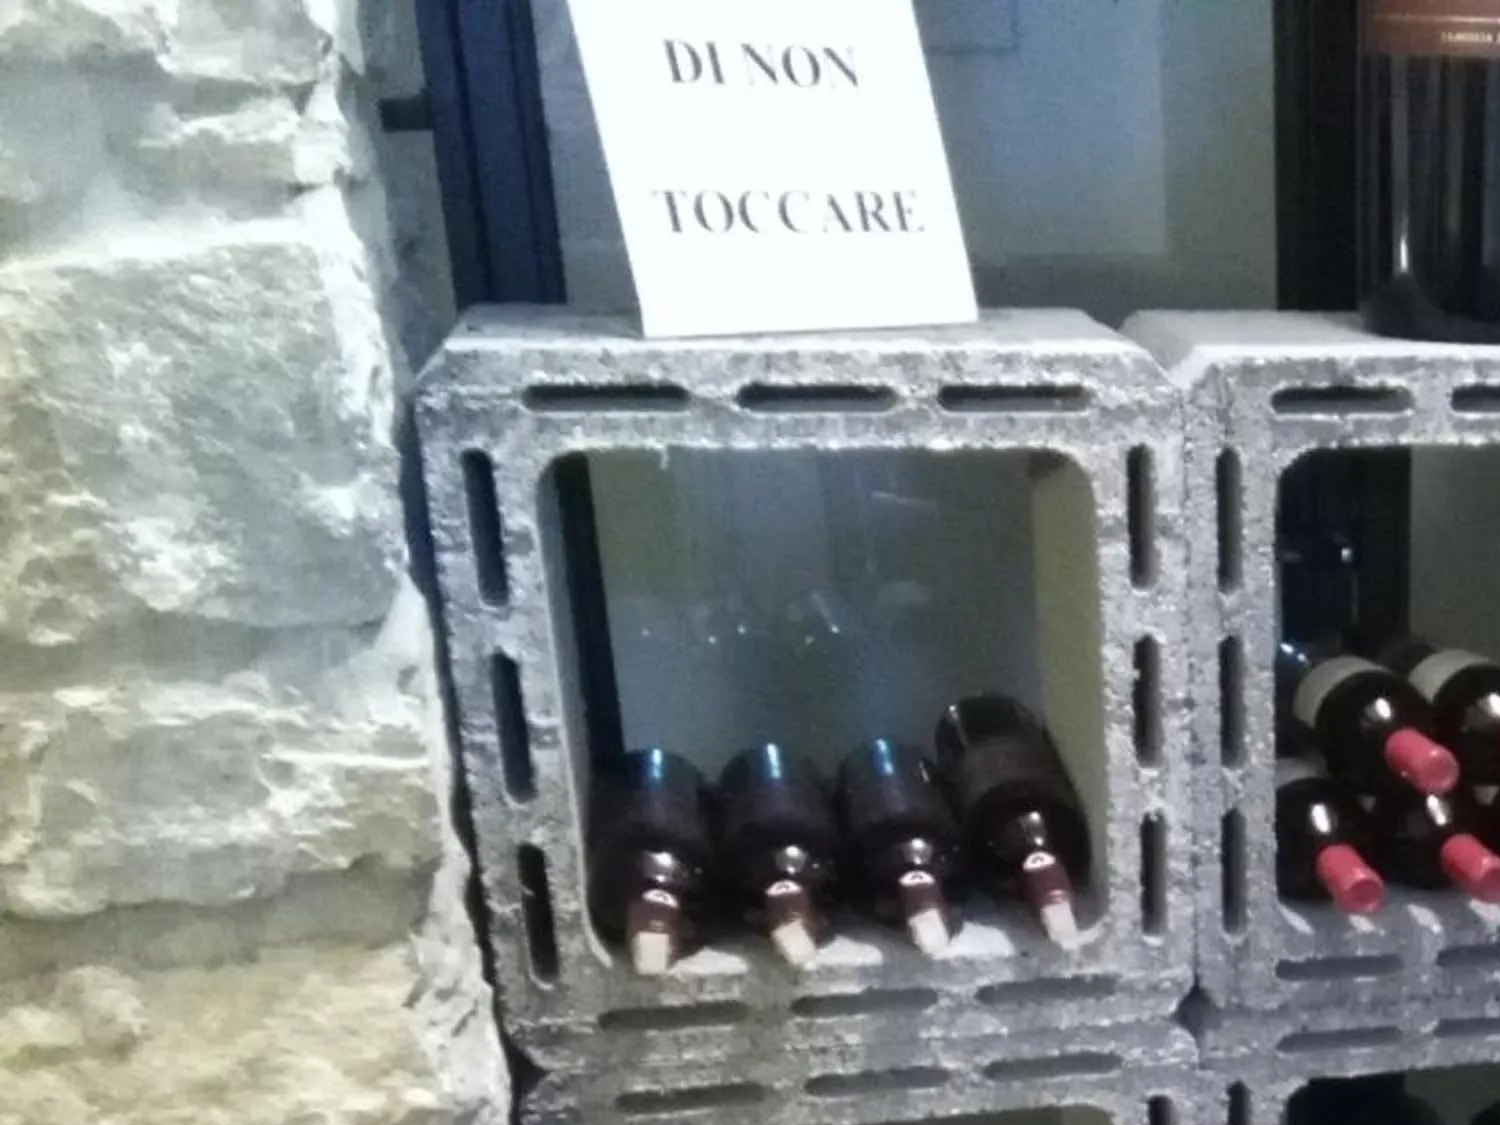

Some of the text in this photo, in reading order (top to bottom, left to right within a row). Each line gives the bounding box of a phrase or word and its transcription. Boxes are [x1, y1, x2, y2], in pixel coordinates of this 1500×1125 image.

[662, 38, 861, 89] DI NON
[651, 188, 926, 234] TOCCARE
